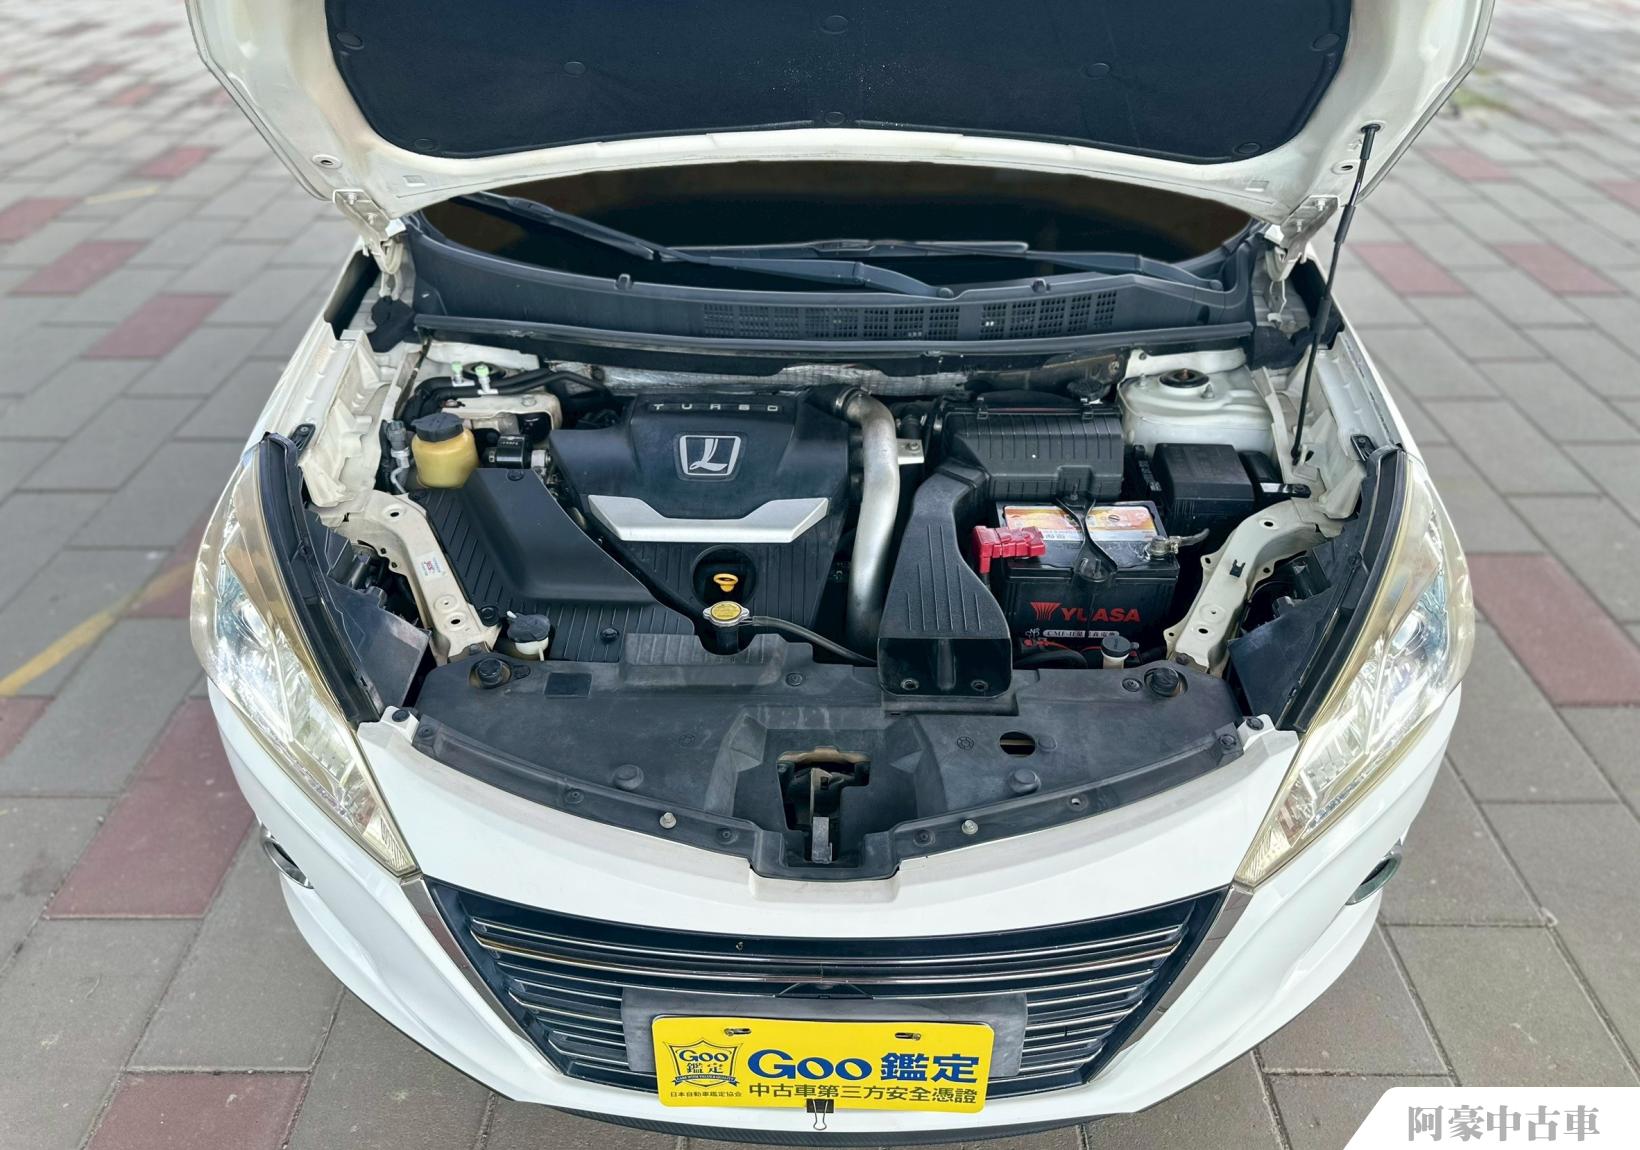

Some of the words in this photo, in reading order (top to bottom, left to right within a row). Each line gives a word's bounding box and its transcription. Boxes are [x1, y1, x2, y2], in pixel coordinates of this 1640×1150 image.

[653, 403, 779, 412] TURBO
[678, 1049, 729, 1063] Goo
[747, 1049, 873, 1081] Goo
[880, 1053, 979, 1083] 鑑定
[748, 1083, 978, 1104] 中古車第三方安全憑證
